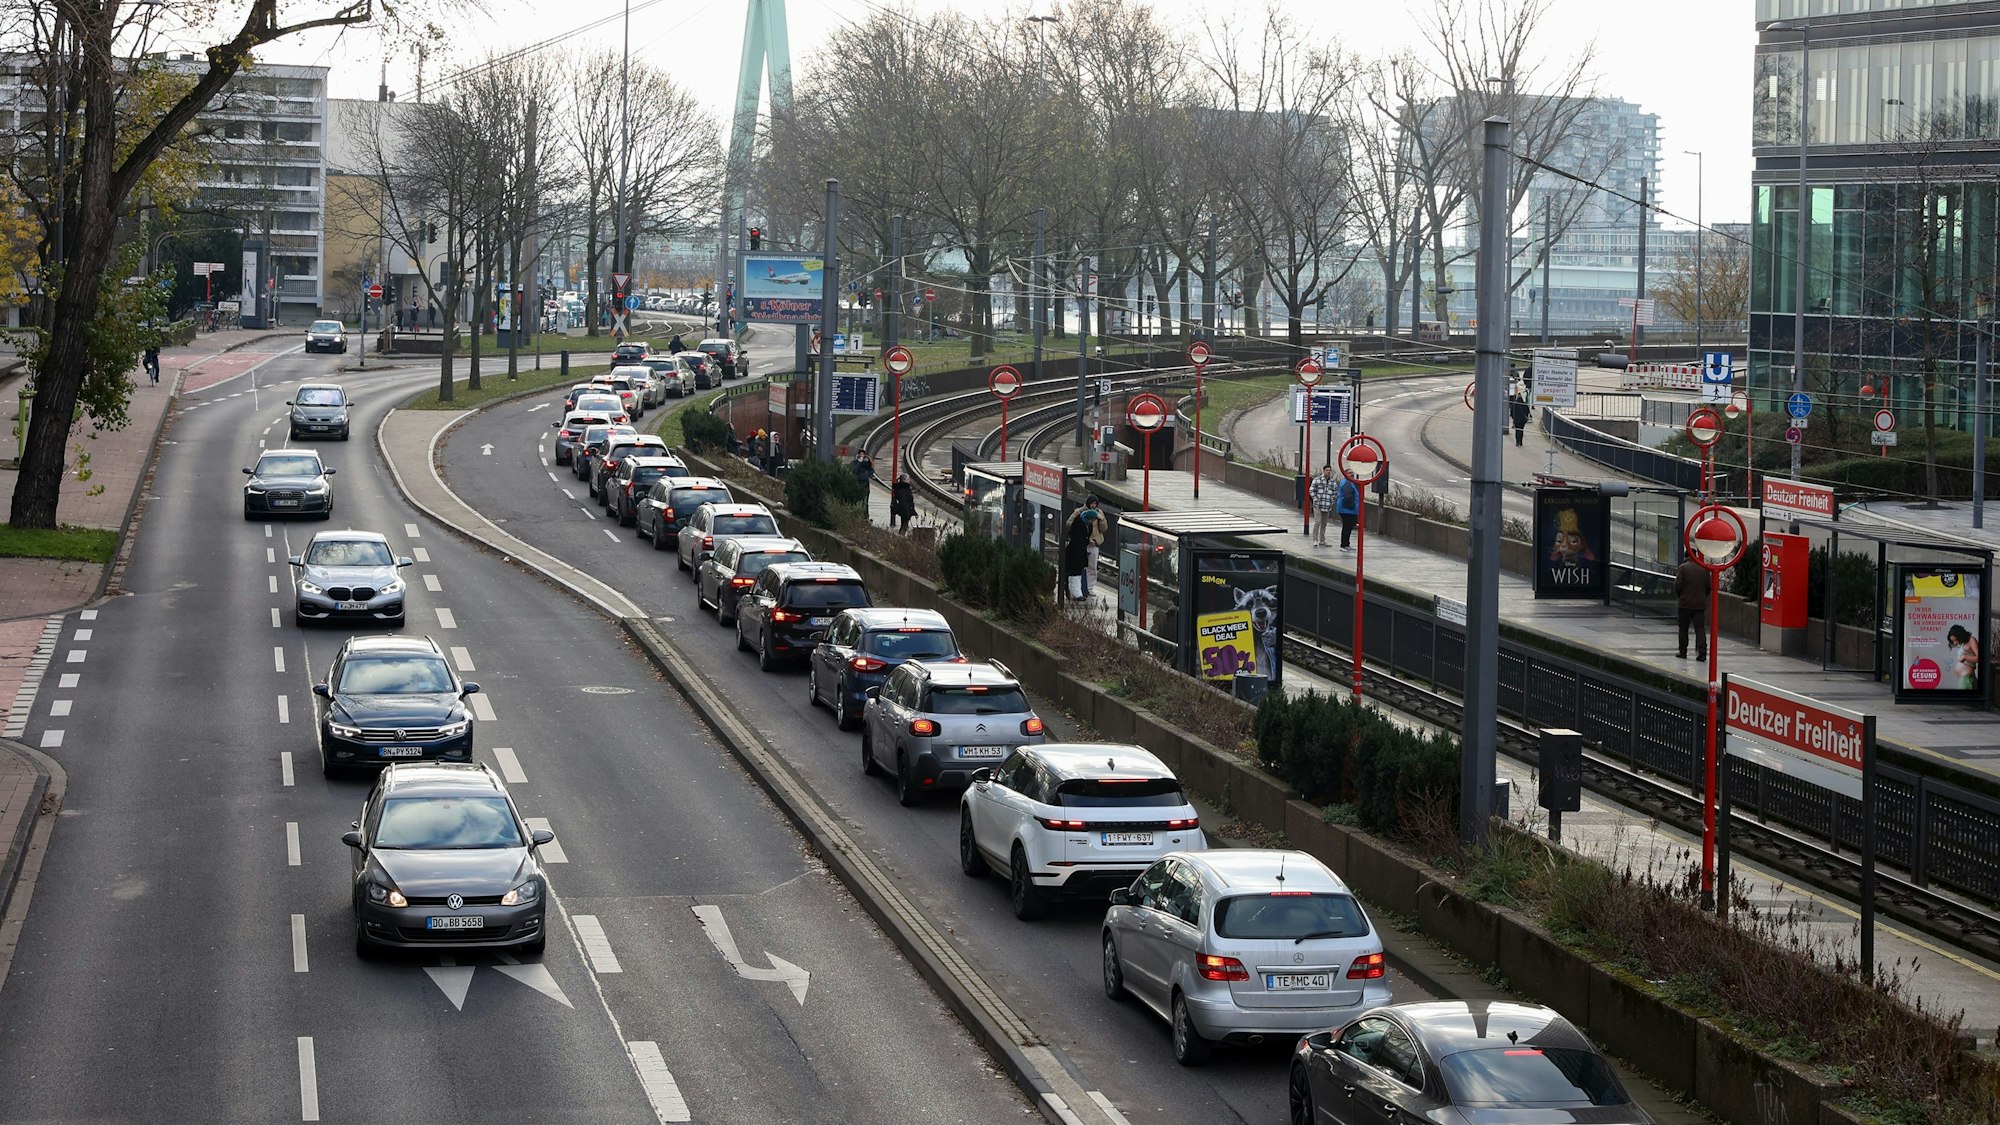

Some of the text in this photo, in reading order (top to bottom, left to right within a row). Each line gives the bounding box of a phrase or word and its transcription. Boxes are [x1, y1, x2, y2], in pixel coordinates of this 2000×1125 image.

[853, 340, 859, 350] 1
[1706, 353, 1729, 381] U
[1102, 380, 1110, 391] 5
[1026, 465, 1060, 491] Deutzer Freiheit
[1767, 484, 1829, 510] Deutzer Freiheit
[1551, 567, 1590, 584] WISH
[1201, 622, 1248, 636] BLACK WEEK
[1215, 632, 1236, 641] DEAL
[1202, 644, 1255, 677] 50%
[1728, 690, 1862, 762] Deutzer Freiheit
[405, 747, 422, 755] 5124
[980, 747, 990, 755] KH
[991, 747, 1001, 755] 53
[449, 918, 460, 927] BB
[461, 917, 483, 927] 5658
[1276, 975, 1325, 987] TE MC 40
